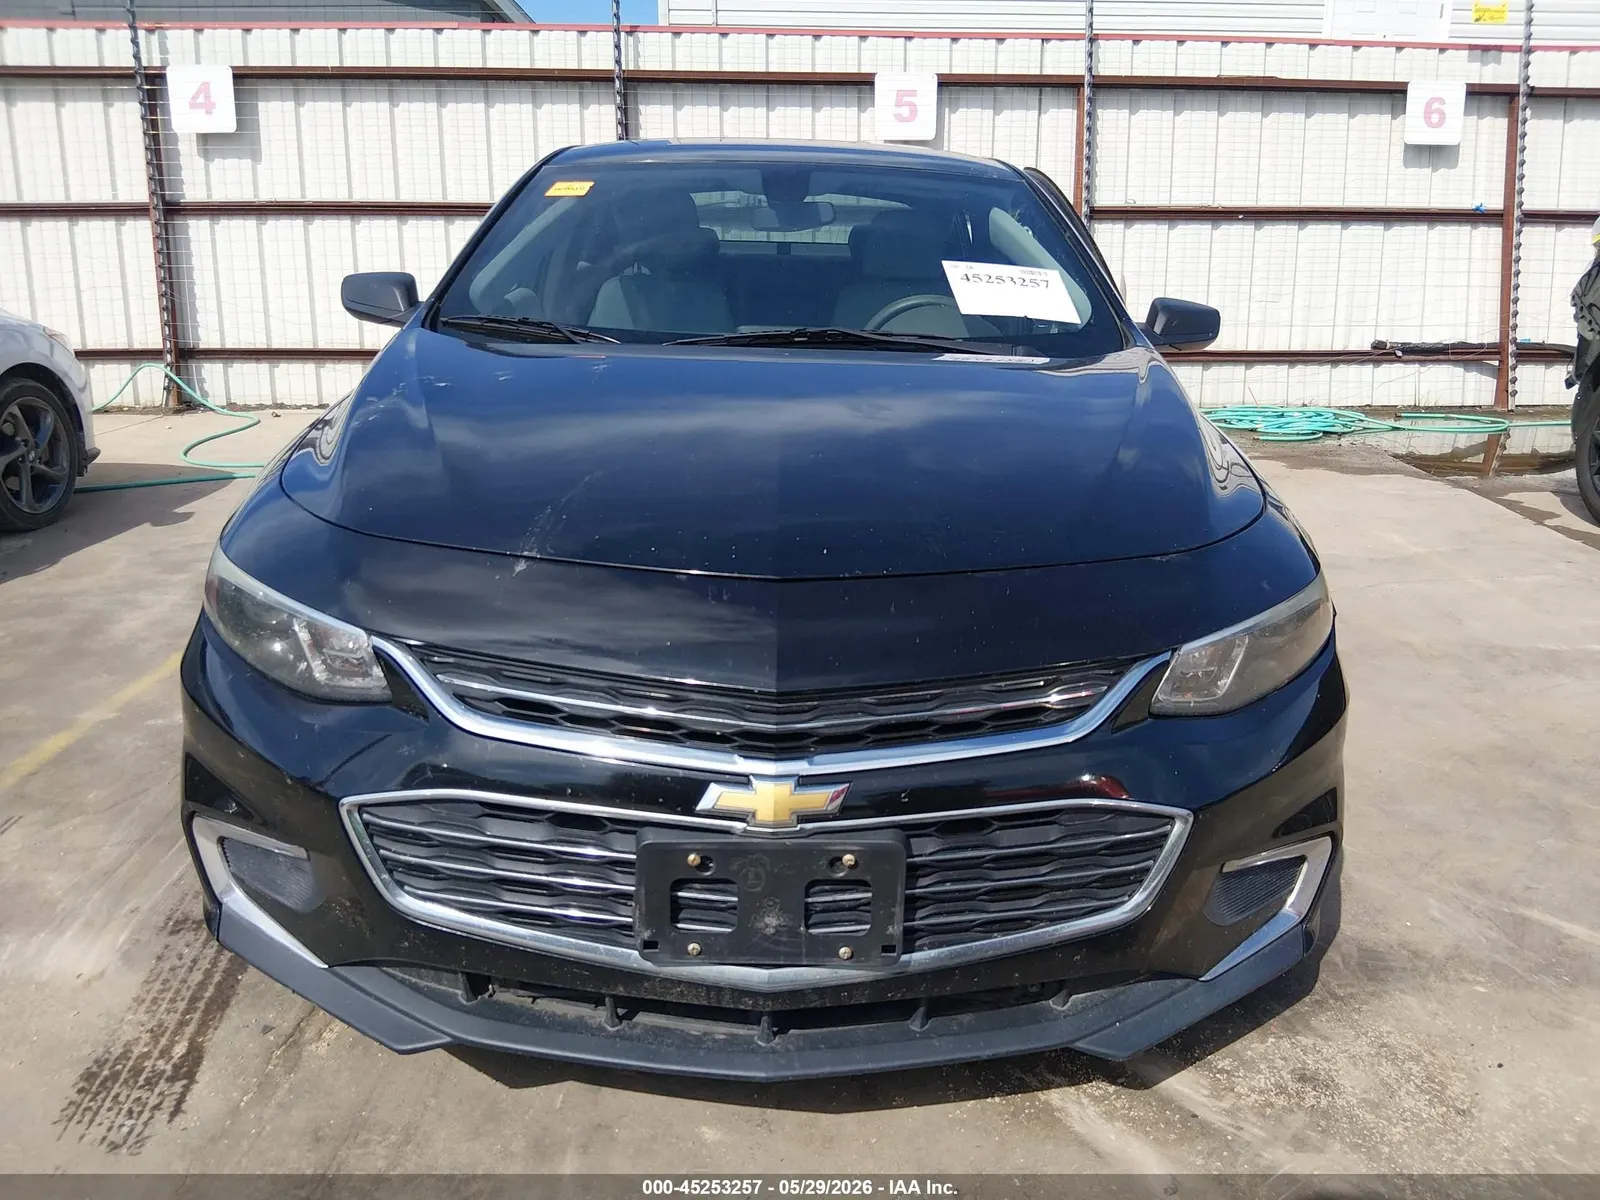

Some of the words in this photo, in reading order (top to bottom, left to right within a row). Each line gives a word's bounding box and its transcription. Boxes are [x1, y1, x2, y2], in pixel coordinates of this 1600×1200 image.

[189, 81, 216, 115] 4
[893, 89, 918, 123] 5
[1423, 96, 1446, 129] 6
[960, 272, 1050, 290] 45253257
